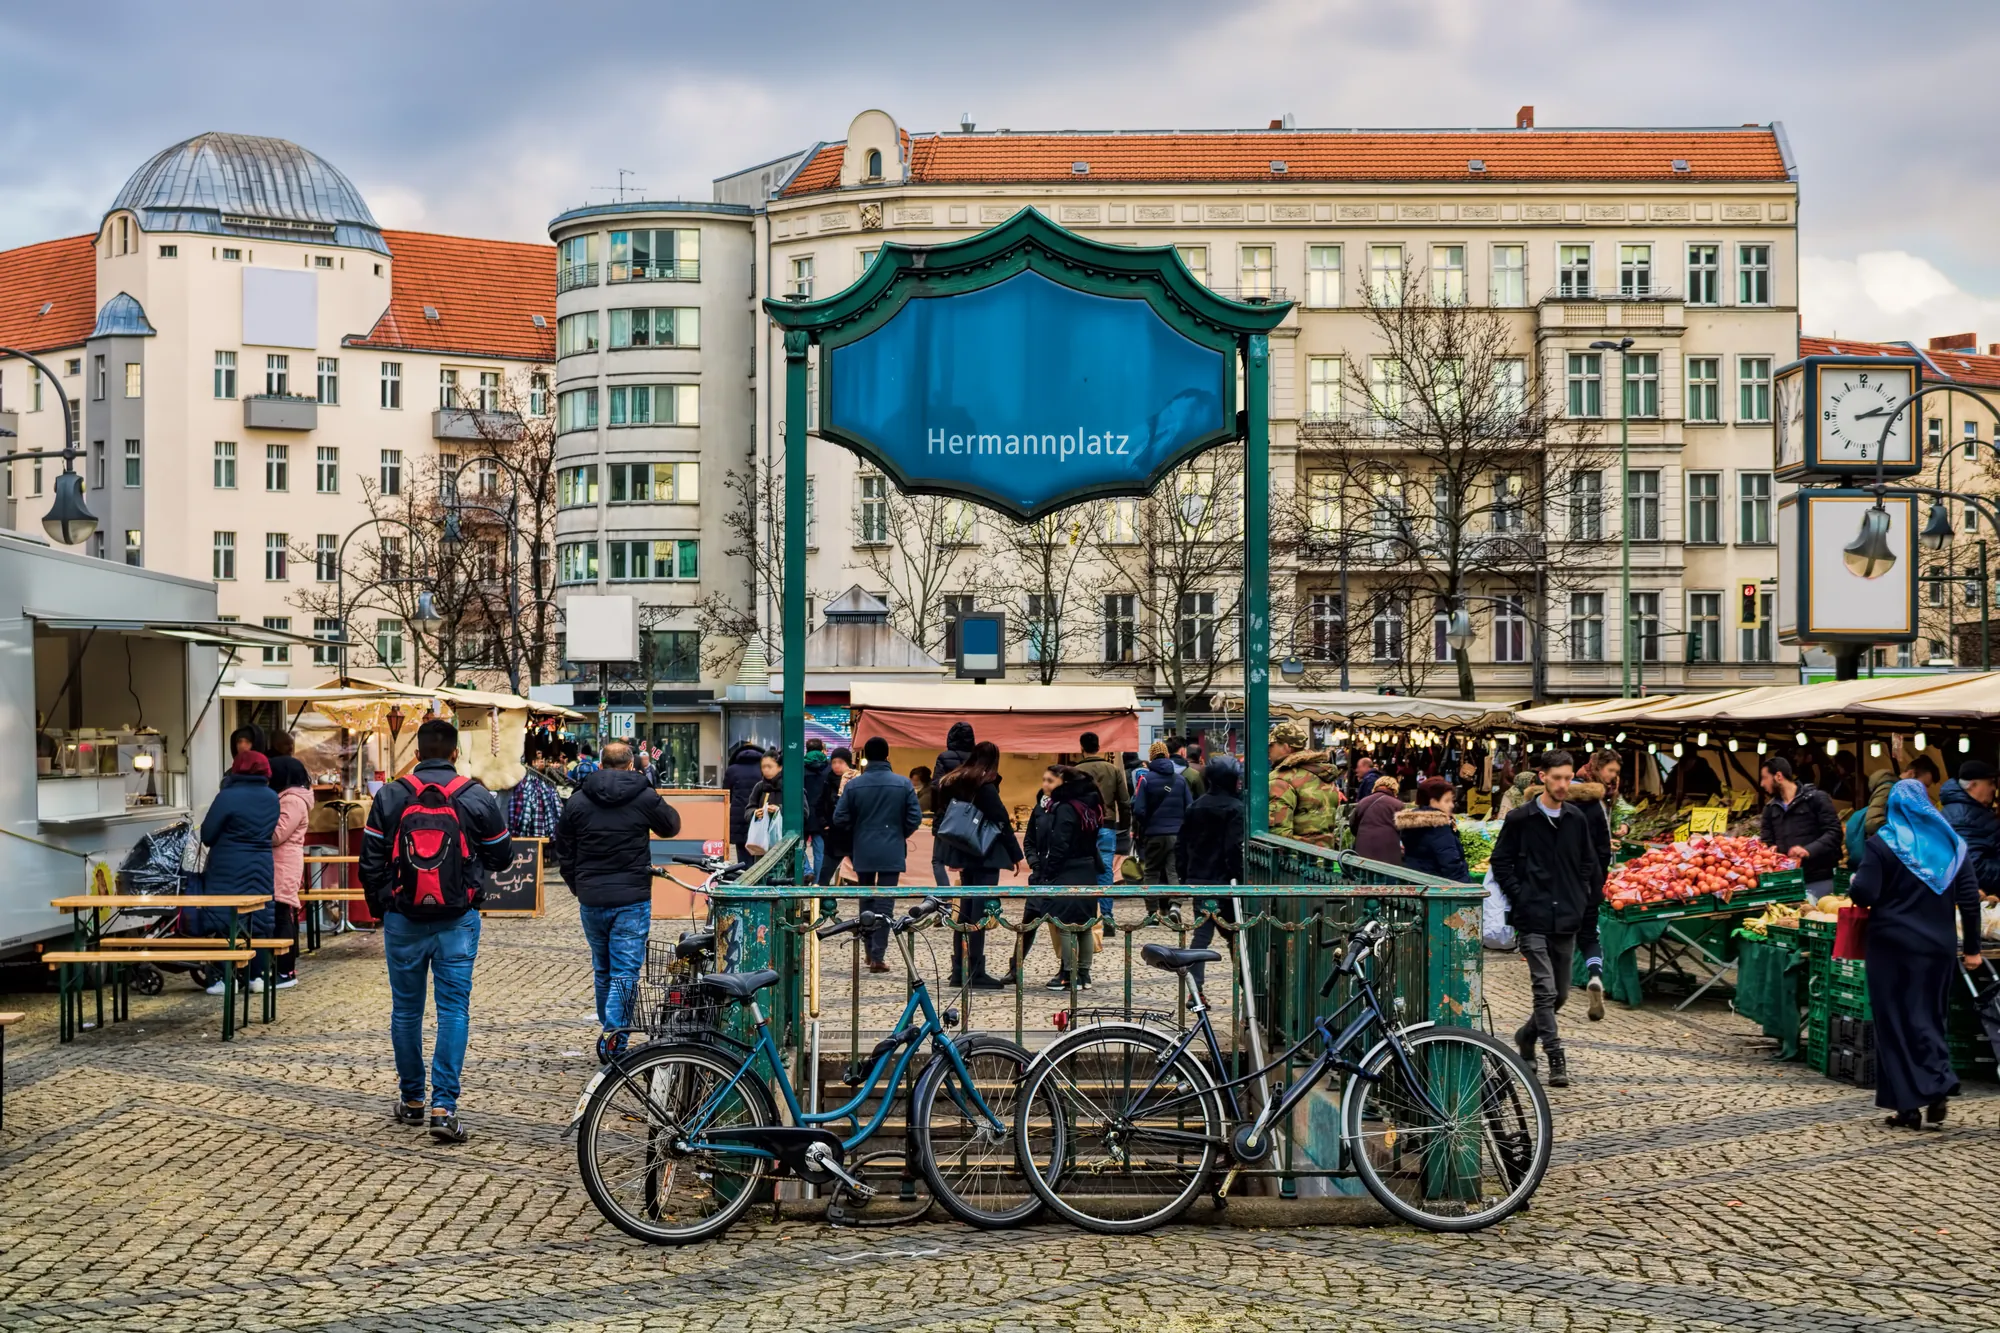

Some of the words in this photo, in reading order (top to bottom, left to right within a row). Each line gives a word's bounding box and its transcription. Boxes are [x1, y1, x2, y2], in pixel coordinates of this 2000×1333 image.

[1859, 373, 1868, 384] 12
[1824, 411, 1830, 420] 9
[1896, 412, 1903, 421] 3
[928, 427, 1129, 462] Hermannplatz
[1861, 449, 1867, 458] 6
